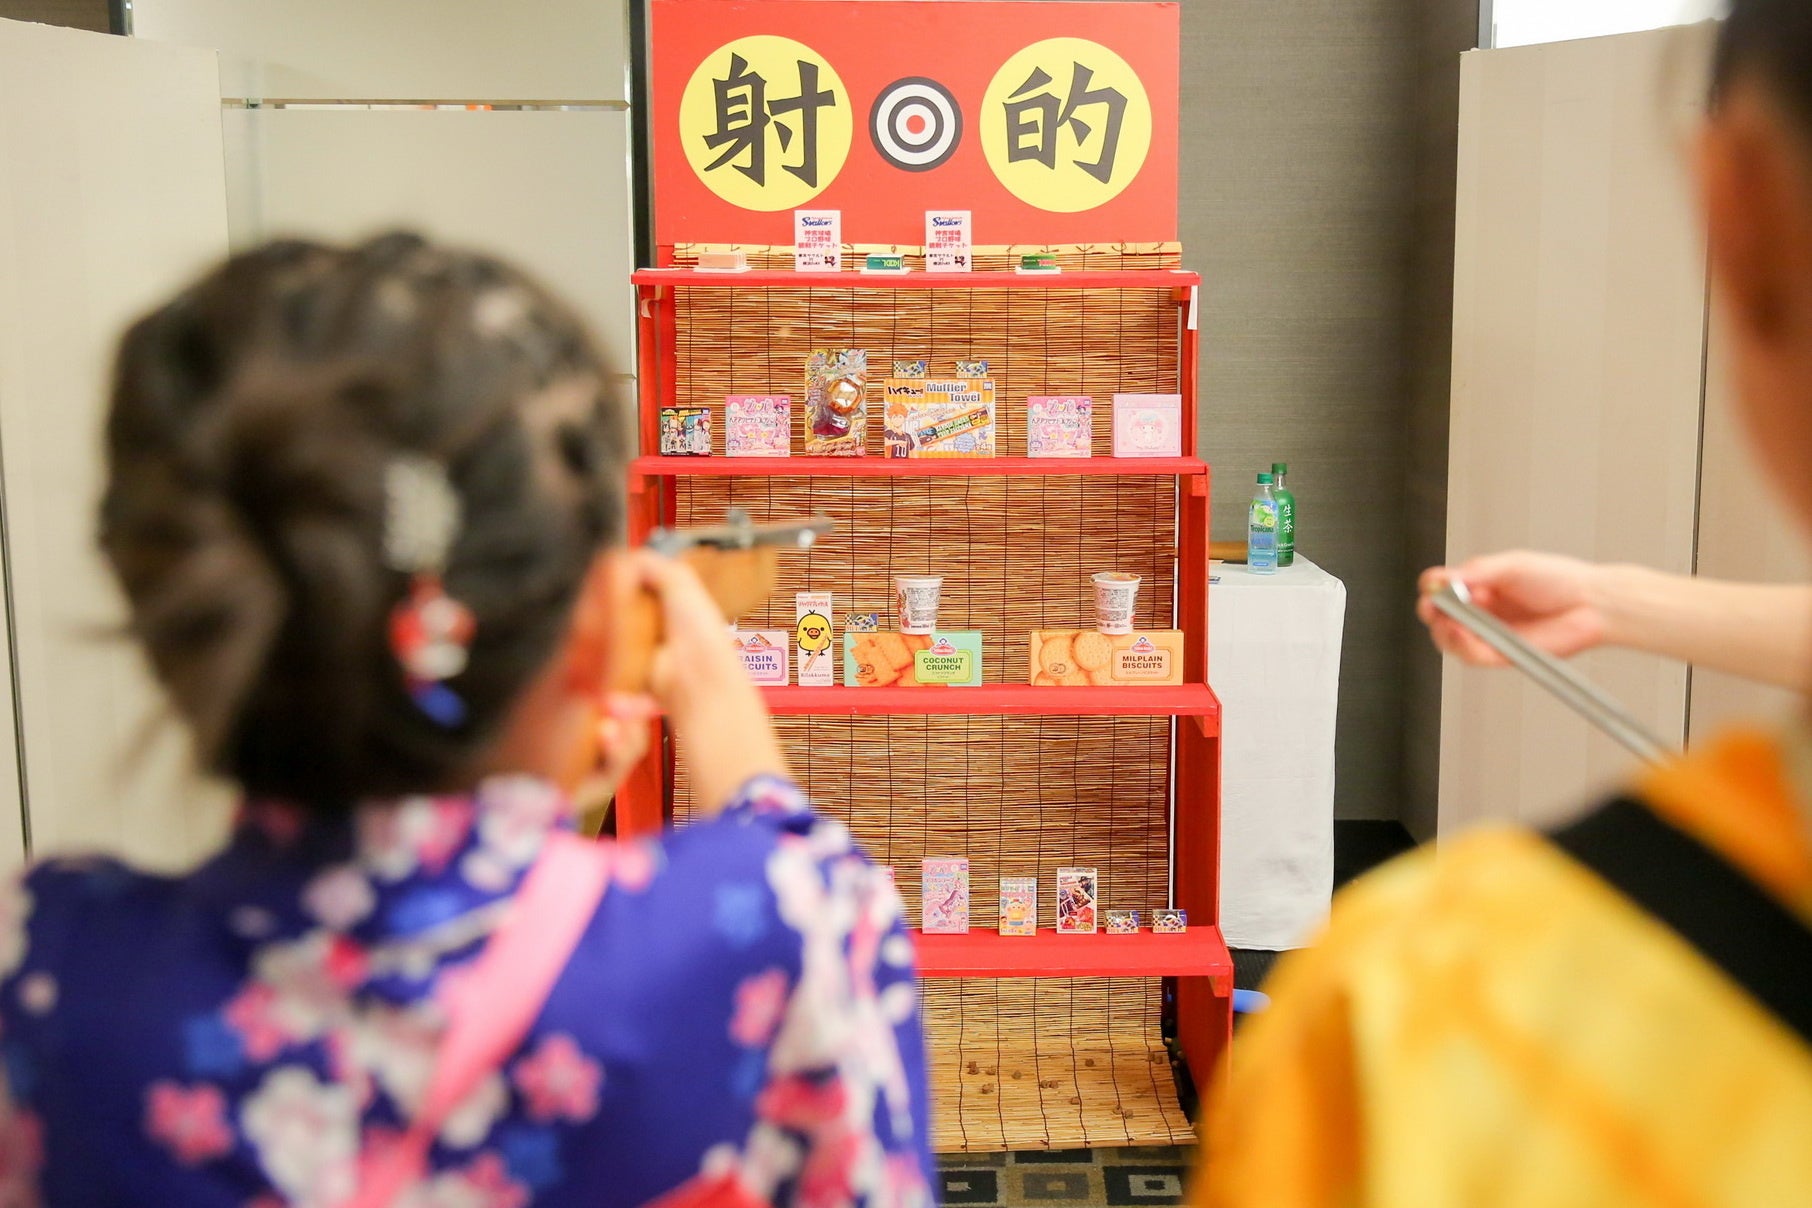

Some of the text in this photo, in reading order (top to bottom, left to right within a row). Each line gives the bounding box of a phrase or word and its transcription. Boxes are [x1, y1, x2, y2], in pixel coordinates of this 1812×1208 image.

[702, 52, 1128, 188] 射 的
[926, 383, 967, 392] Muffler
[949, 393, 980, 402] Towel
[1283, 504, 1293, 533] 生茶
